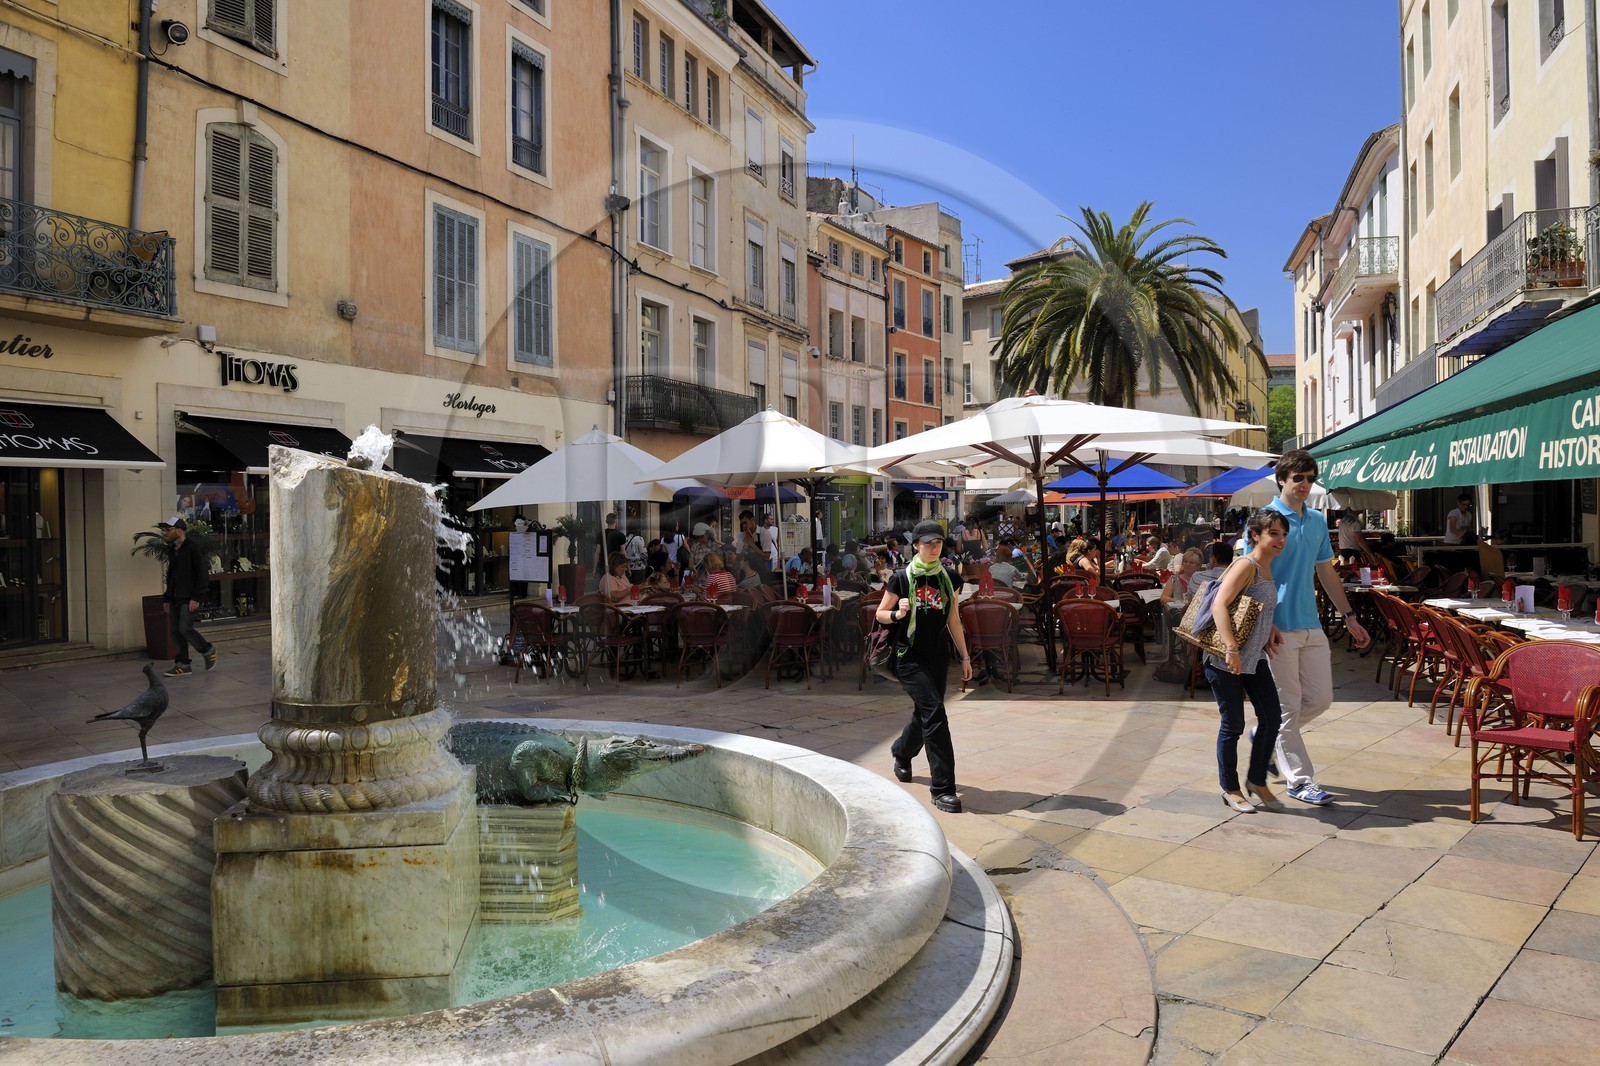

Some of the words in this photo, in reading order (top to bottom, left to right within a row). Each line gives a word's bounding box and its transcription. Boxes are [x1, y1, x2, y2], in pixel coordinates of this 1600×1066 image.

[216, 350, 299, 392] THOMAS
[443, 393, 496, 418] Horloger
[0, 434, 99, 455] HOMAS
[1356, 442, 1438, 483] Courtois
[1448, 426, 1528, 467] RESTAURATION
